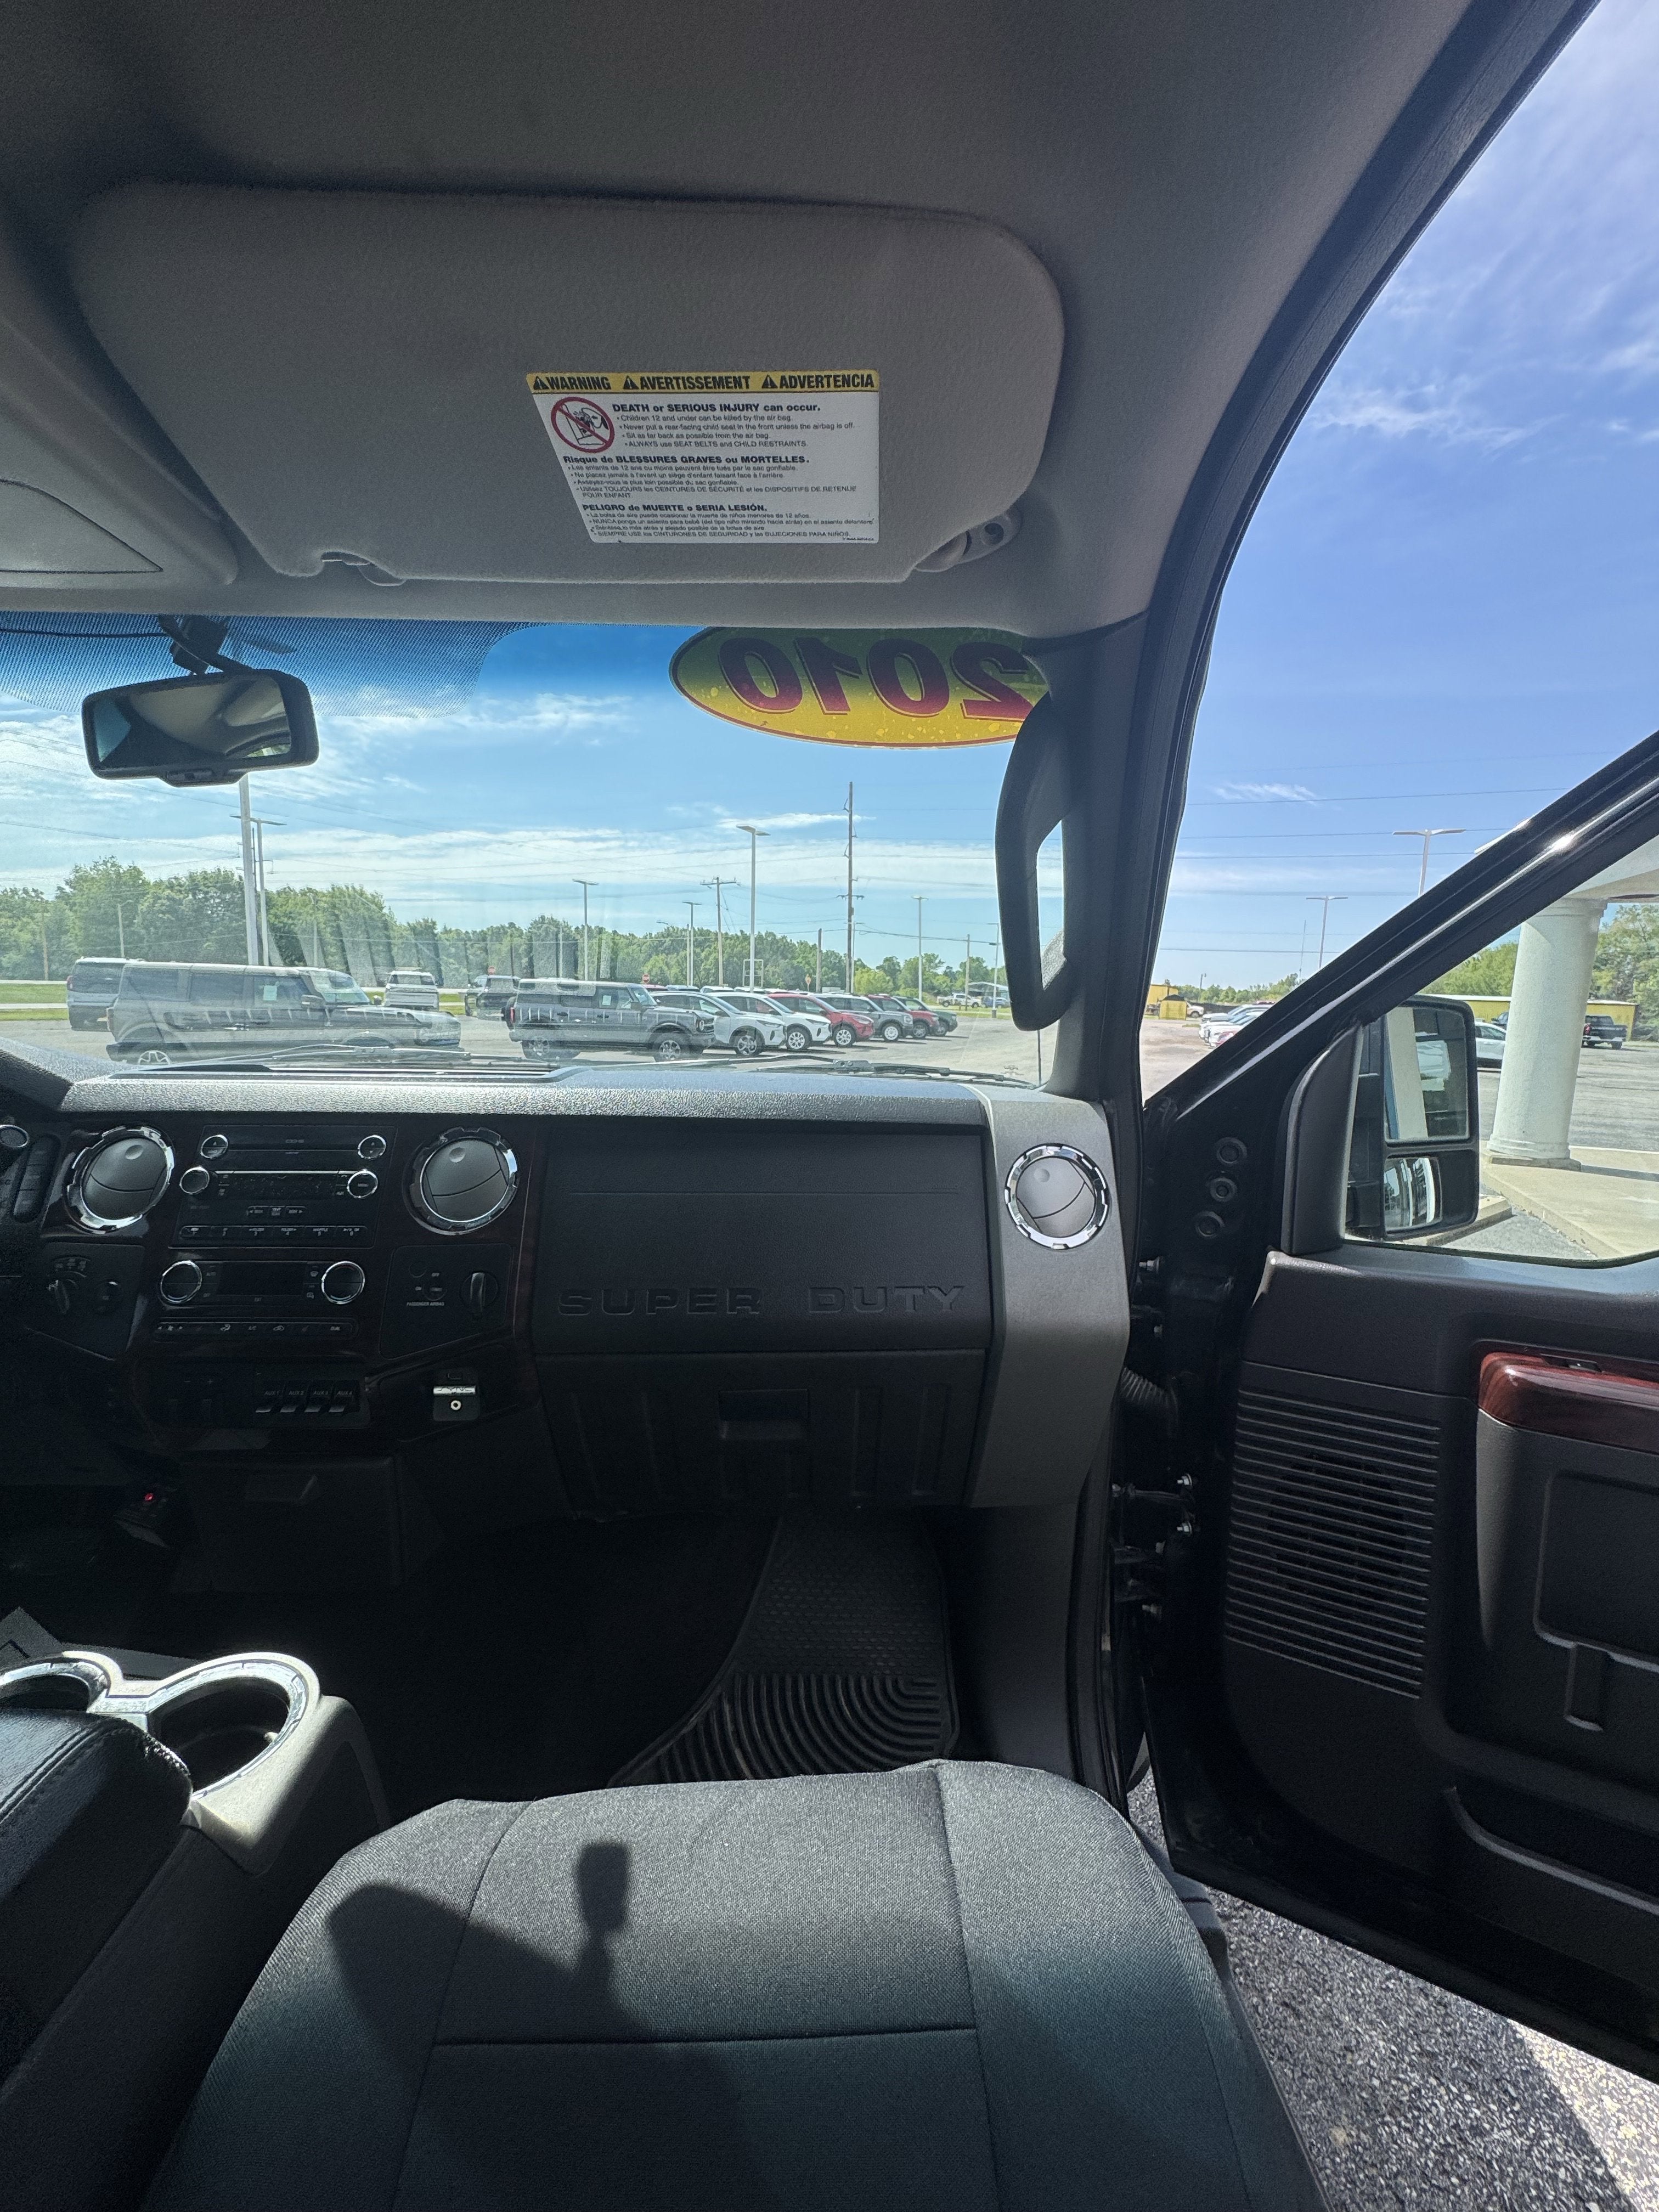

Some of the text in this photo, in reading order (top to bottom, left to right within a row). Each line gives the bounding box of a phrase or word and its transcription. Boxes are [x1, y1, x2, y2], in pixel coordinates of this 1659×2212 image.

[546, 374, 874, 390] WARNING AVERTISSEMENT ADVERTENCIA
[612, 403, 650, 411] DEATH
[667, 403, 716, 411] SERIOUS
[719, 403, 759, 411] INJURY
[813, 422, 834, 431] airbag
[563, 456, 598, 464] Risque
[557, 1285, 966, 1316] SUPER DUTY
